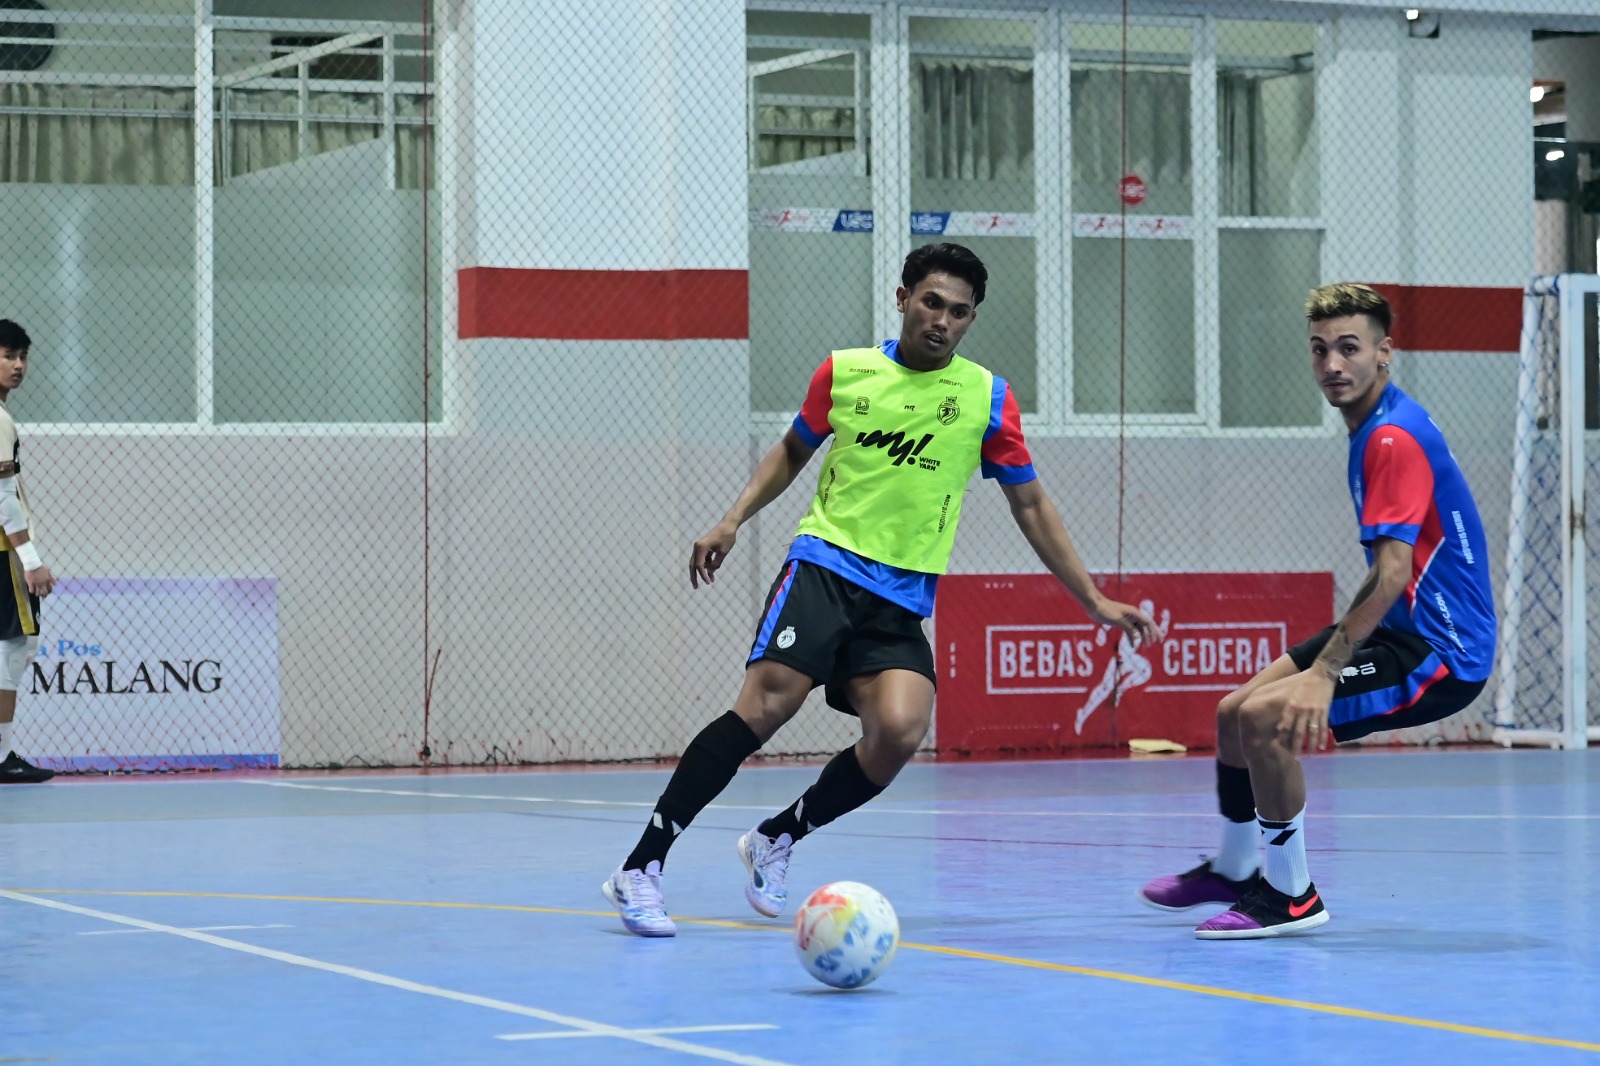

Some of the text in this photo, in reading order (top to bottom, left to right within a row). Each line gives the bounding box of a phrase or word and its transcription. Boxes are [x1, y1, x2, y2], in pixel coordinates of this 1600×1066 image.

[919, 456, 941, 466] WHITE
[919, 463, 936, 471] YARN
[57, 639, 102, 657] Pos
[998, 639, 1094, 679] BEBAS
[1162, 636, 1273, 676] CEDERA
[1359, 661, 1376, 676] 10
[30, 659, 223, 695] MALANG
